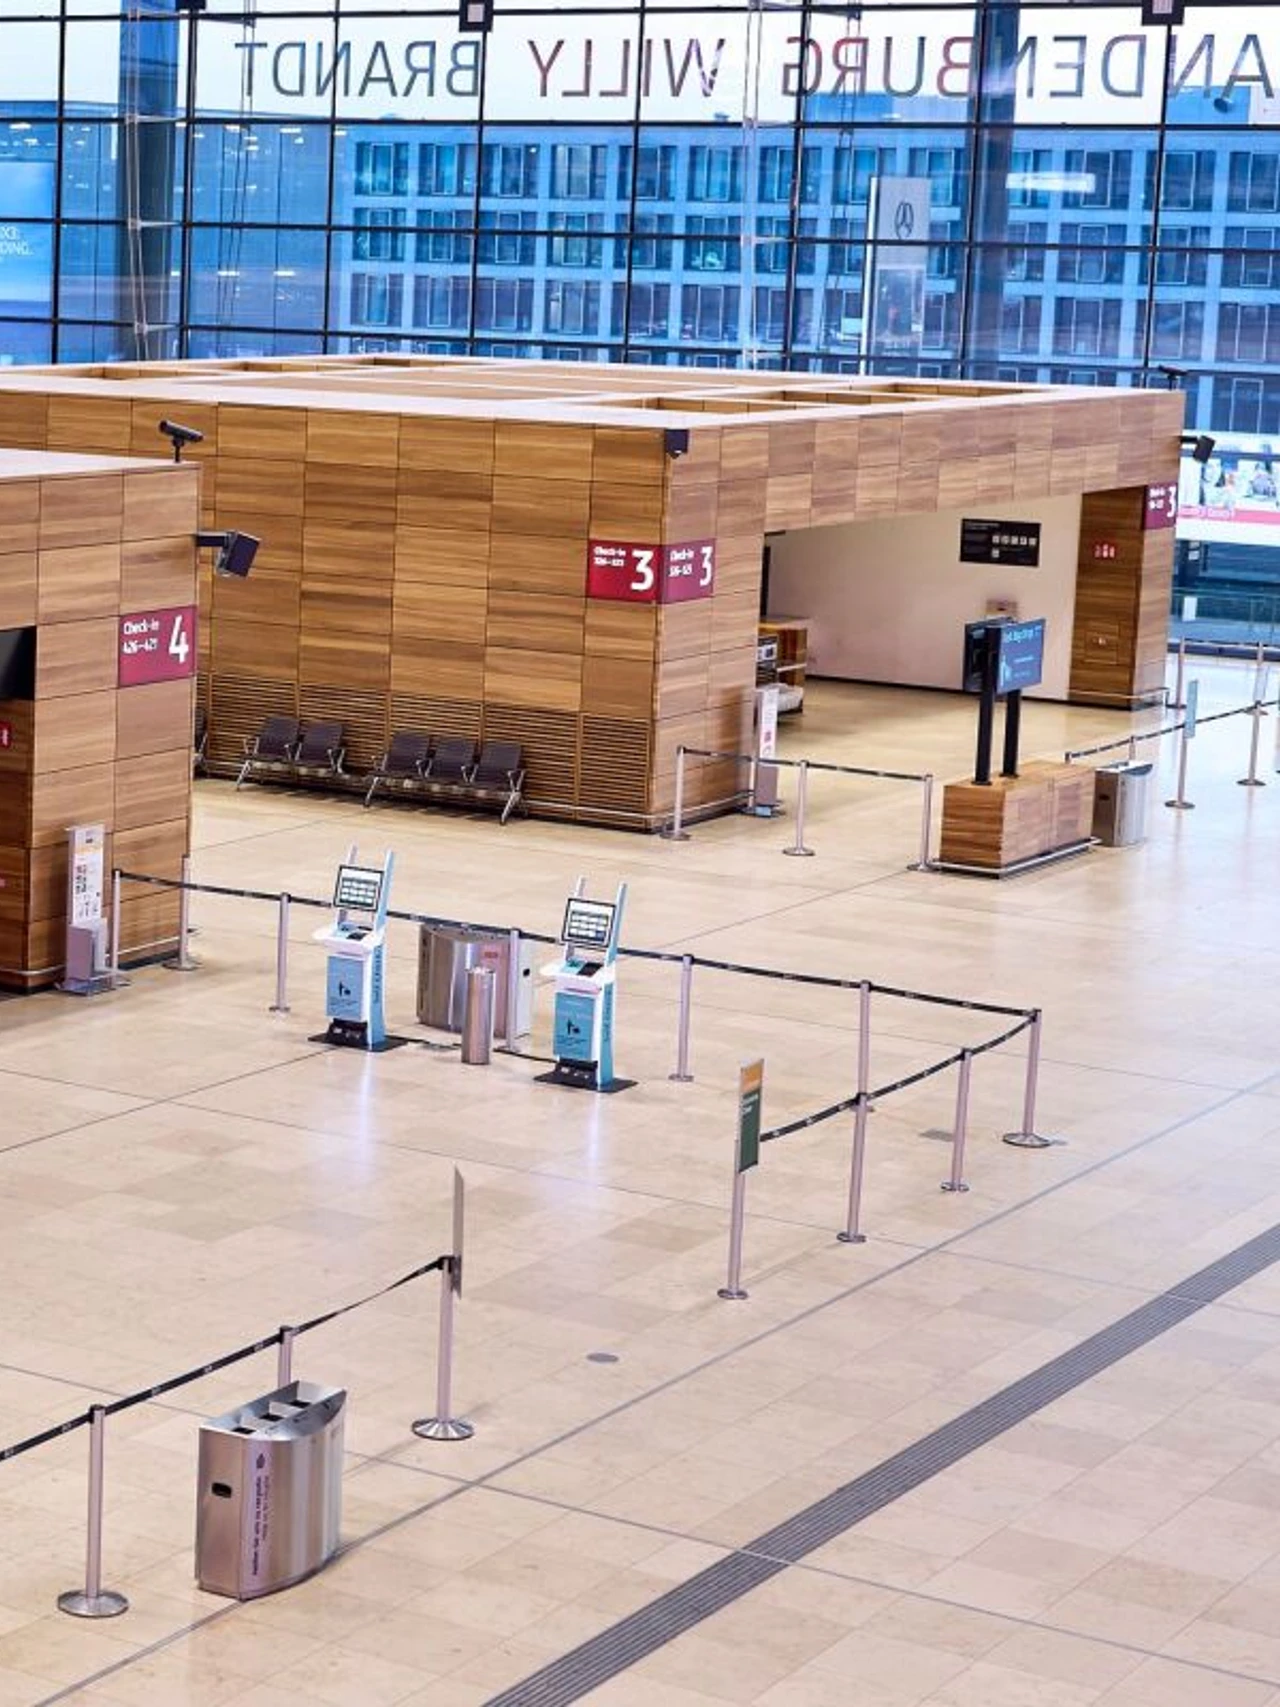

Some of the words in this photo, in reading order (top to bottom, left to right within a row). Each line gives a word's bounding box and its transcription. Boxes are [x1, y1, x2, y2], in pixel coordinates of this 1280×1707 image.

[631, 549, 654, 591] 3
[700, 546, 713, 587] 3
[123, 618, 160, 635] Check-in
[168, 614, 189, 664] 4
